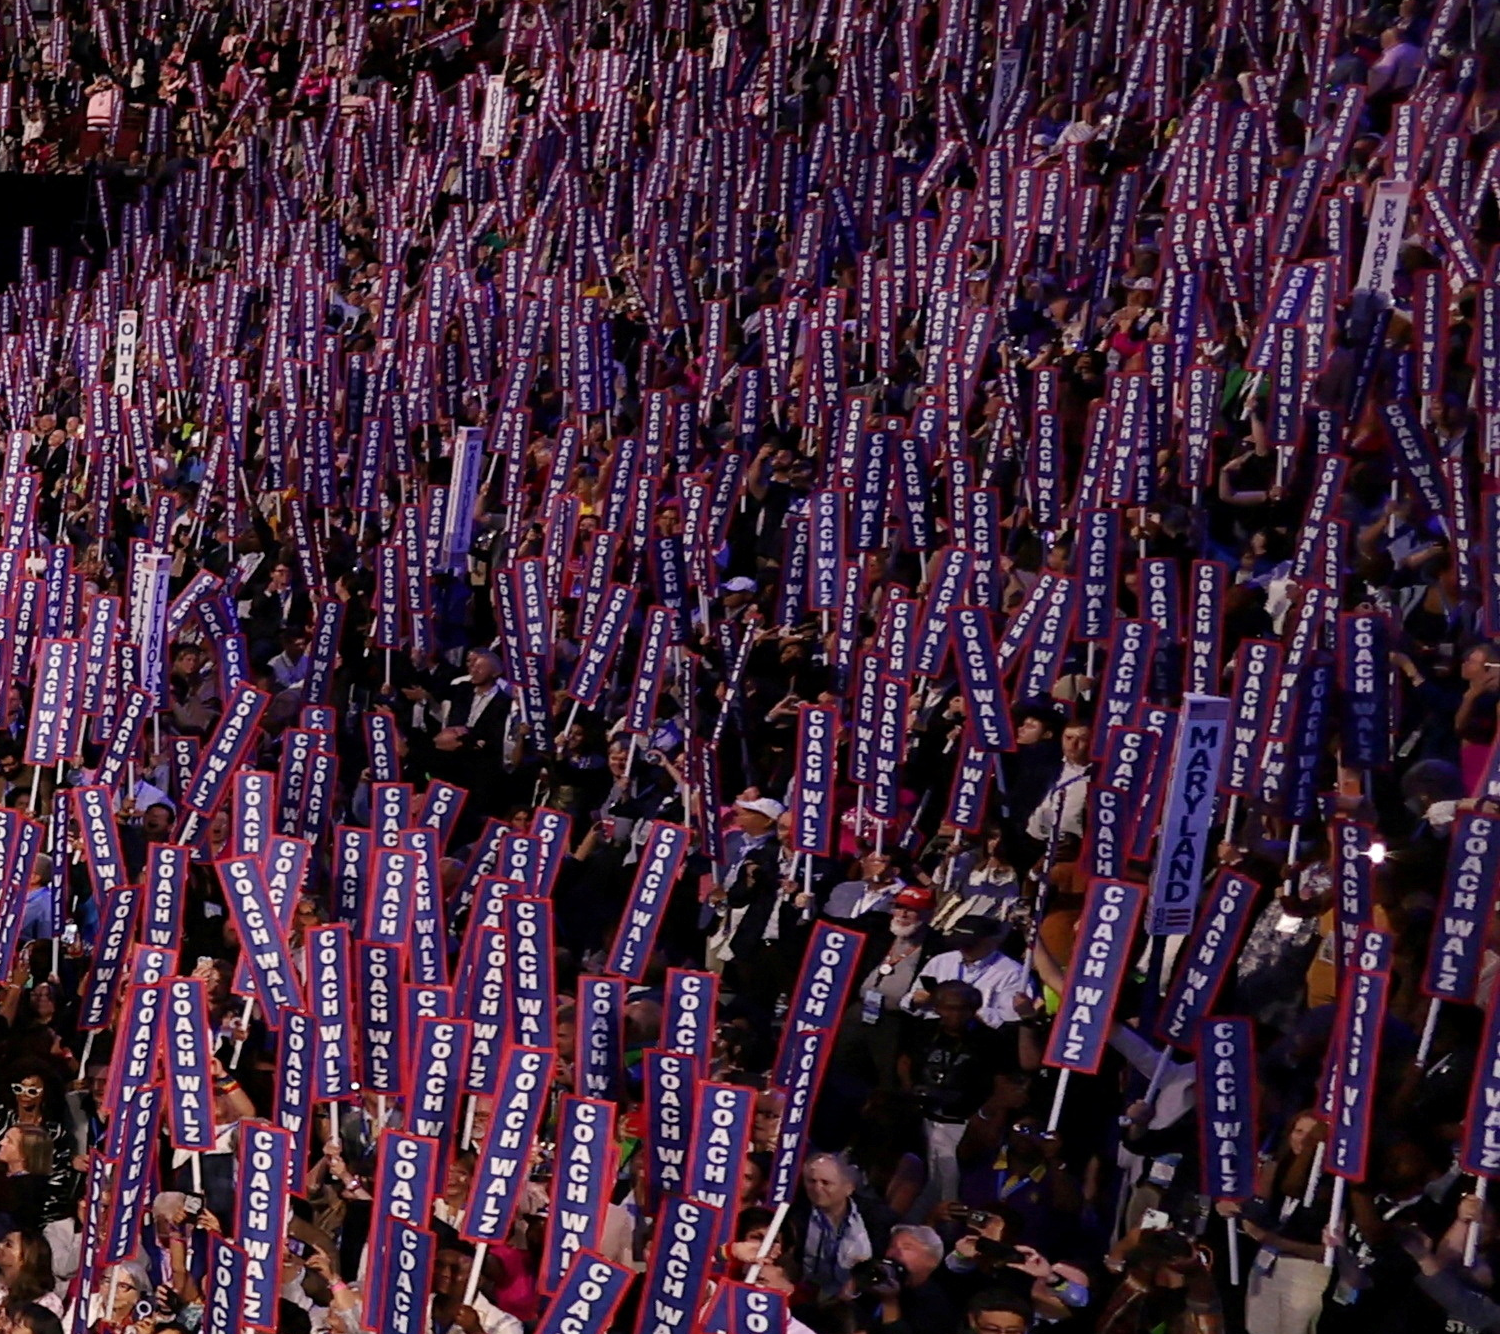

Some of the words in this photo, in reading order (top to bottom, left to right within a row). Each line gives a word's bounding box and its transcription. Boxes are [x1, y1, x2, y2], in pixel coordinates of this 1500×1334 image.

[117, 322, 134, 396] OHIO
[1165, 727, 1219, 883] MARYLAND
[1083, 886, 1126, 979] COACH
[1062, 986, 1104, 1061] WALZ
[499, 1054, 541, 1150] COACH
[479, 1156, 518, 1235] WALZ
[394, 1228, 418, 1334] COACH
